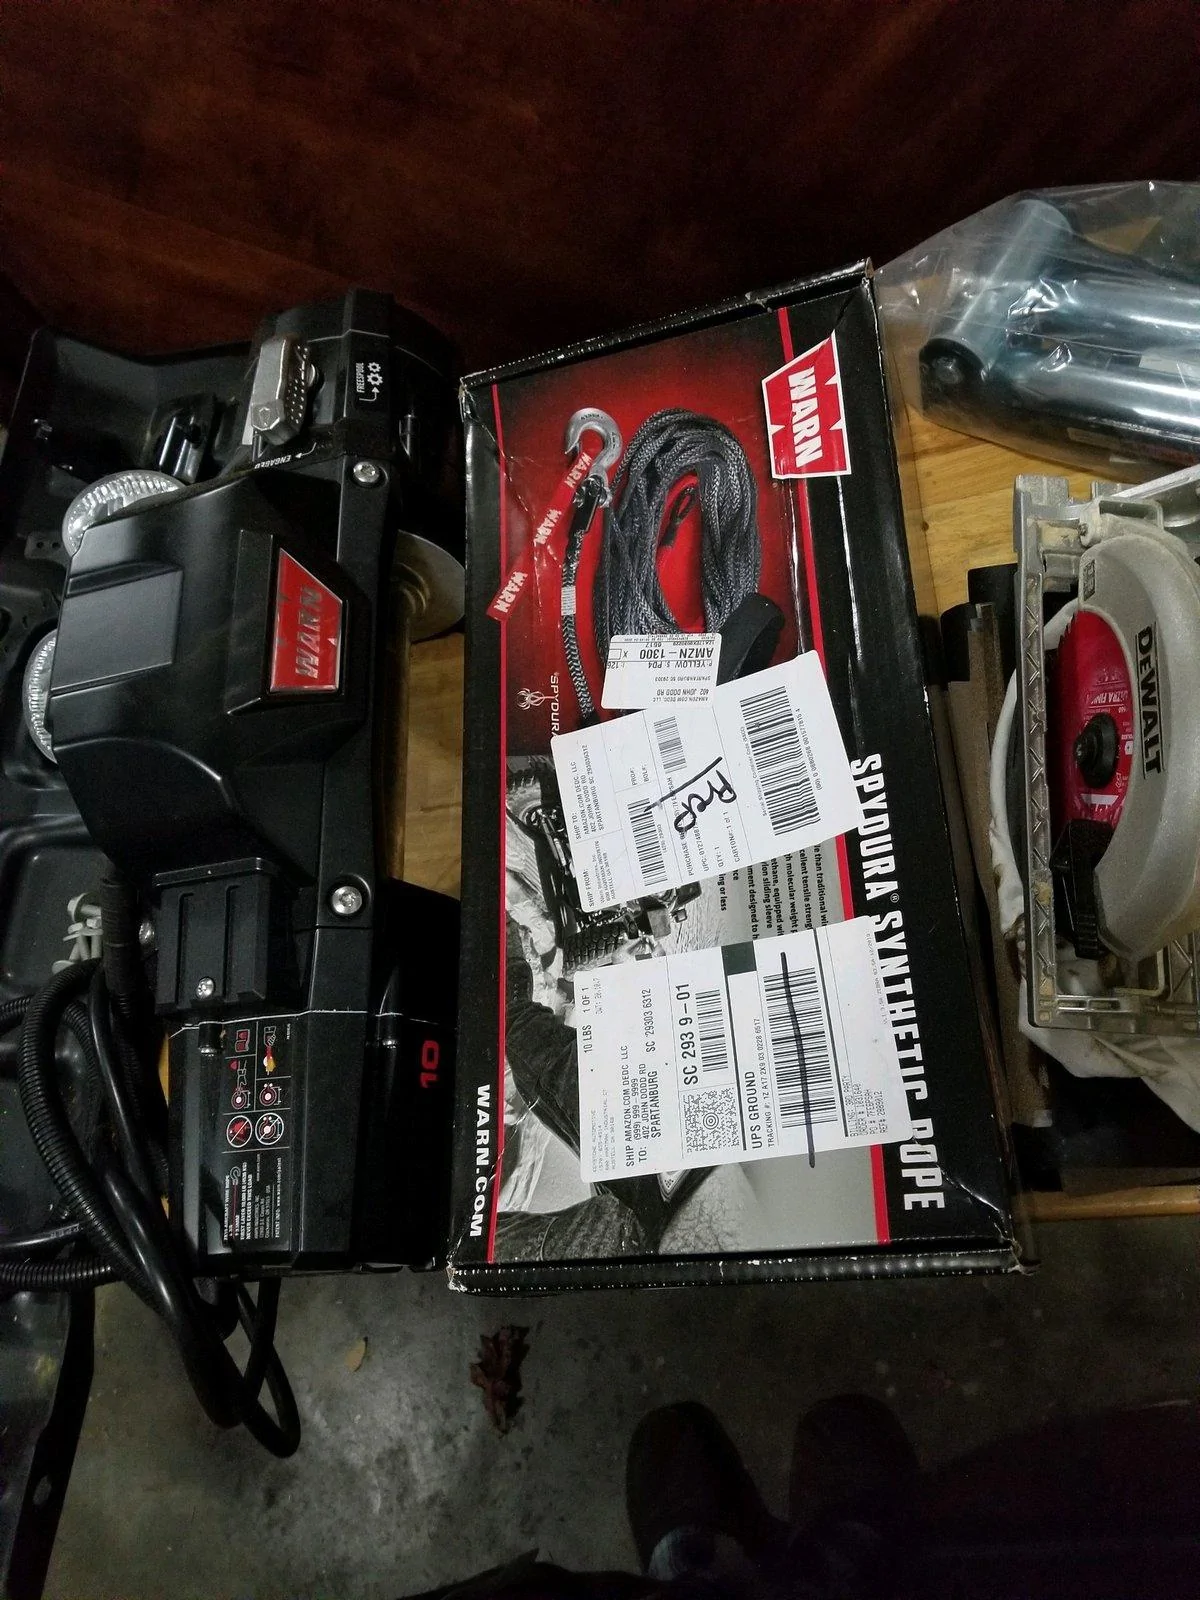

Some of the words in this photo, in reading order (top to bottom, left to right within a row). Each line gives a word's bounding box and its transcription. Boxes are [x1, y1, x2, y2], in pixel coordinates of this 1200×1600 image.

[355, 362, 365, 393] FREESPOOL
[788, 366, 823, 468] WARN
[254, 455, 292, 469] ENGAGED
[564, 452, 593, 488] WARN
[533, 509, 562, 545] WARN
[493, 571, 528, 613] WARN
[295, 585, 322, 679] WARN
[623, 650, 628, 658] X
[674, 660, 706, 668] YELLOW
[699, 688, 709, 696] 402
[1139, 626, 1161, 774] DEWALT
[570, 761, 578, 773] LLC
[580, 774, 587, 784] RD
[589, 776, 595, 784] SC
[582, 785, 591, 803] DODD
[586, 804, 594, 820] JOHN
[590, 786, 604, 831] SPARTANBURG
[573, 825, 582, 840] SHIP
[681, 842, 694, 876] PURCHASE
[716, 851, 724, 868] QTY:
[814, 854, 822, 872] than
[582, 869, 591, 890] FROM:
[786, 863, 796, 900] molecular
[801, 875, 812, 902] tensile
[587, 891, 595, 907] SHIP
[718, 886, 726, 895] or
[762, 877, 773, 904] sliding
[816, 872, 828, 914] traditional
[719, 896, 729, 911] less
[748, 889, 760, 923] designed
[773, 887, 784, 923] equipped
[765, 904, 774, 929] sleeve
[789, 901, 799, 928] weight
[752, 924, 759, 932] to
[582, 994, 590, 1006] OF
[641, 988, 651, 1009] 6312
[581, 1024, 592, 1041] LBS
[643, 1011, 654, 1037] 29303
[582, 1043, 592, 1054] 10
[620, 1045, 628, 1060] LLC
[645, 1042, 655, 1053] SC
[679, 1031, 696, 1059] 293
[756, 1035, 764, 1050] 0228
[420, 1040, 439, 1088] 10
[758, 1052, 765, 1060] 03
[869, 909, 928, 1101] SYNTHETIC
[900, 1117, 945, 1211] ROPE
[621, 1064, 630, 1086] DEDC
[638, 1063, 646, 1075] RD
[682, 1064, 698, 1085] SC
[638, 1077, 648, 1099] DODD
[841, 1075, 851, 1092] PARTY
[647, 1070, 661, 1139] SPARTANBURG
[744, 1071, 760, 1121] GROUND
[762, 1092, 769, 1100] 1Z
[621, 1089, 632, 1142] AMAZON.COM
[639, 1101, 648, 1123] JOHN
[632, 1121, 641, 1141] (999)
[641, 1125, 650, 1140] 402
[764, 1111, 775, 1148] TRACKING
[847, 1109, 858, 1137] BILLING:
[869, 1127, 878, 1135] PO
[749, 1125, 763, 1150] UPS
[470, 1084, 491, 1237] WARN.COM
[624, 1145, 635, 1167] SHIP
[637, 1146, 648, 1163] TO:
